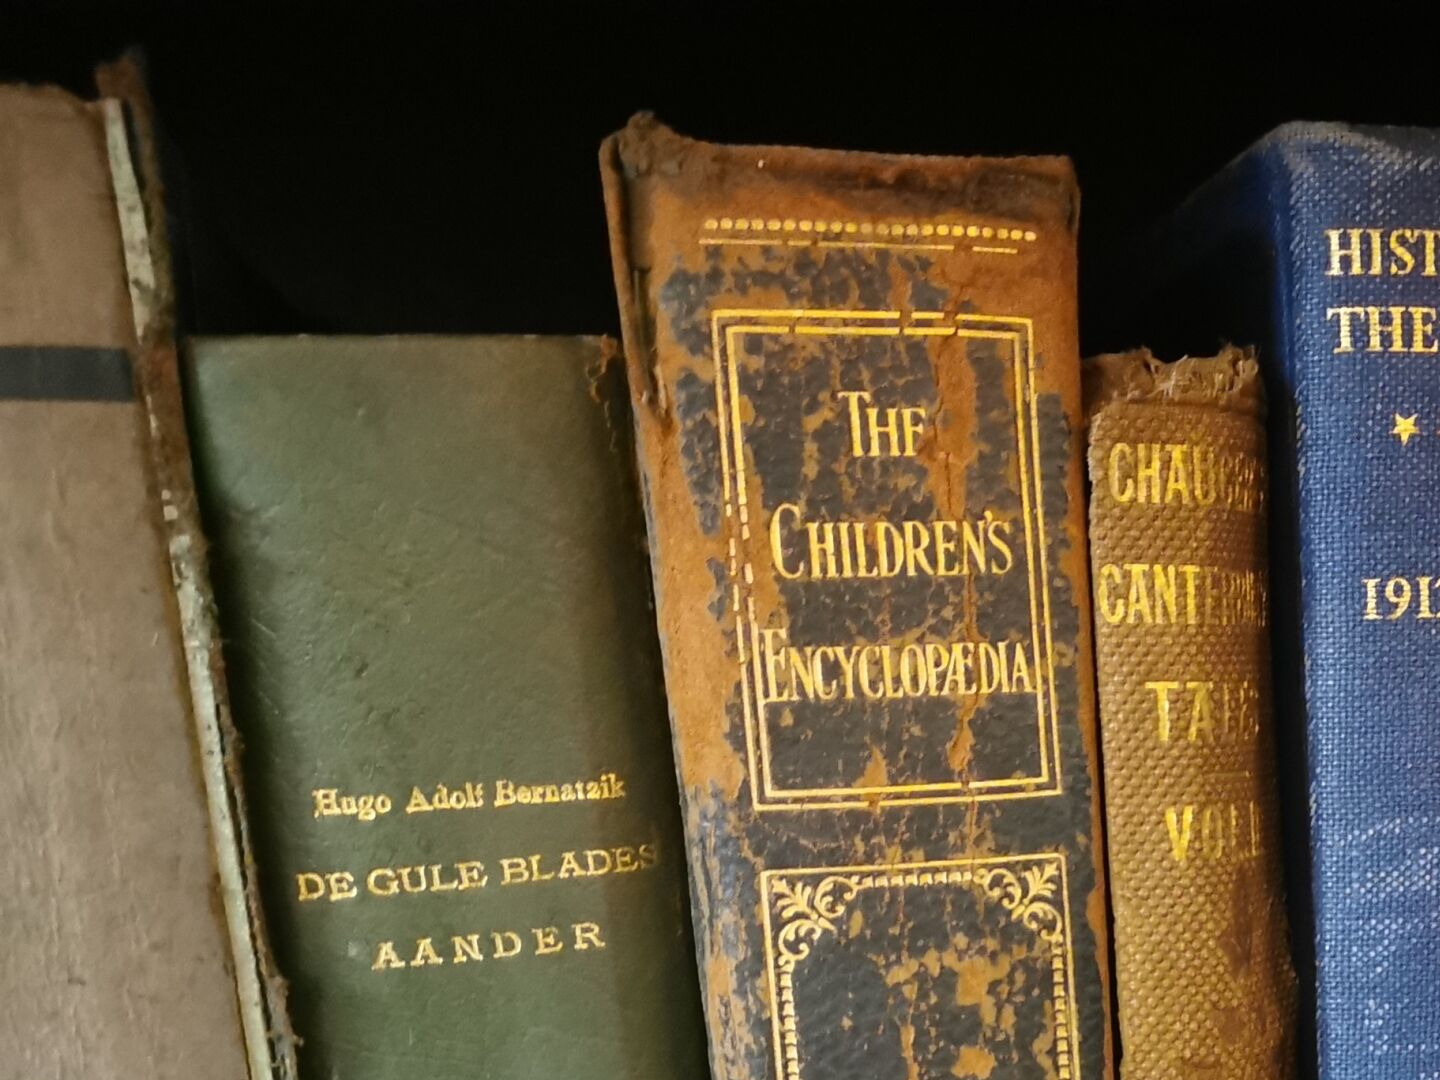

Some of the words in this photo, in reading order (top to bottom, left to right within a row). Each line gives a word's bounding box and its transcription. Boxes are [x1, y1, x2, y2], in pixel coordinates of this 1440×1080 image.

[1326, 305, 1439, 354] THE
[837, 390, 927, 458] THE
[768, 503, 1014, 580] CHILDREN'S
[759, 626, 1038, 703] ENCYCLOPÆDIA
[312, 787, 391, 822] Hugo
[405, 781, 484, 814] Adolf
[494, 772, 627, 808] Bernatzik
[296, 871, 357, 903] DE
[366, 860, 489, 897] GULE
[499, 842, 659, 886] BLADES
[370, 921, 606, 972] AANDER
